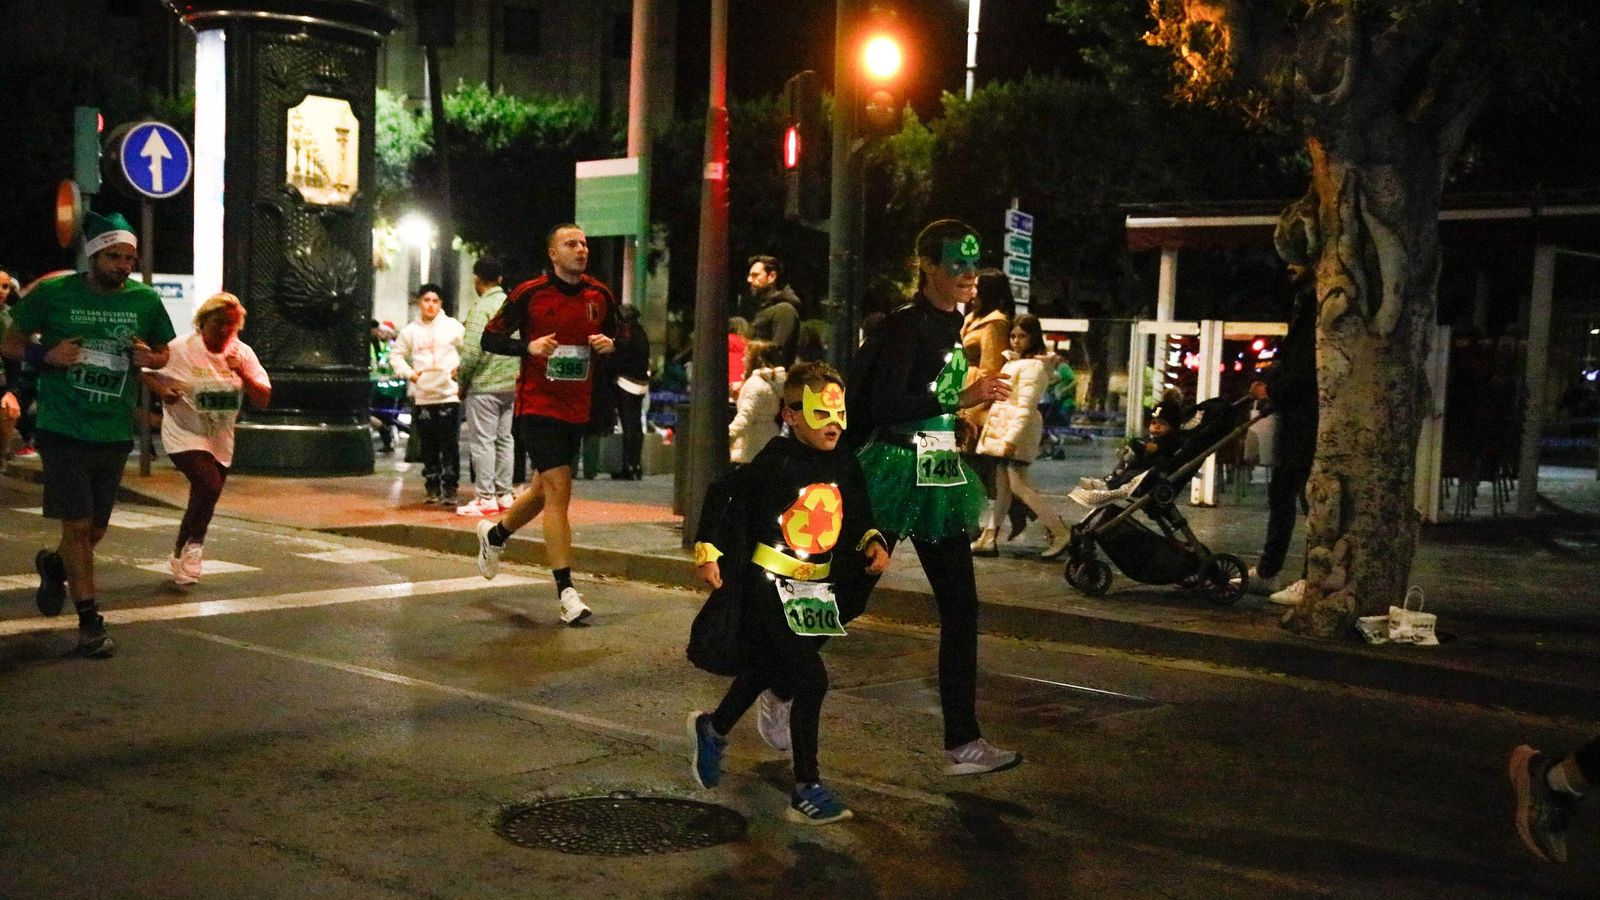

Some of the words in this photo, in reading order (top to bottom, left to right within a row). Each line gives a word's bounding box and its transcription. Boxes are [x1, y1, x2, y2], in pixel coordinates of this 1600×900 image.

[102, 311, 138, 319] SILVESTRE
[72, 367, 121, 390] 1607
[555, 363, 583, 376] 395
[790, 606, 837, 629] 1610
